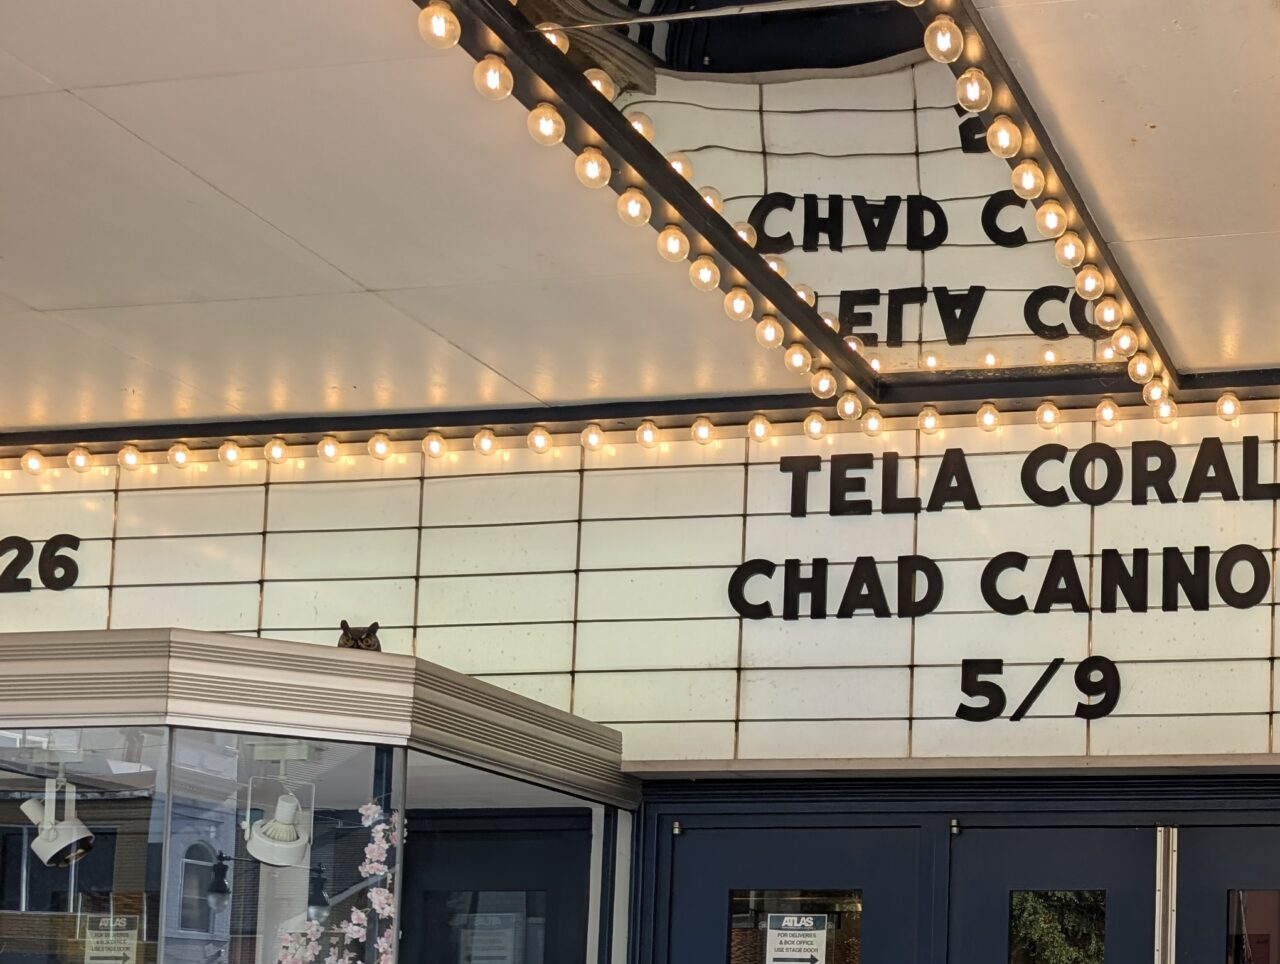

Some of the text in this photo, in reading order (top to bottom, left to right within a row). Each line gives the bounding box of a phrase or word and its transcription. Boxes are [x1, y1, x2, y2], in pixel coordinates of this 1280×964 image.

[780, 448, 981, 517] TELA
[728, 555, 944, 620] CHAD
[956, 655, 1121, 721] 5/9
[781, 916, 814, 927] ATLAS
